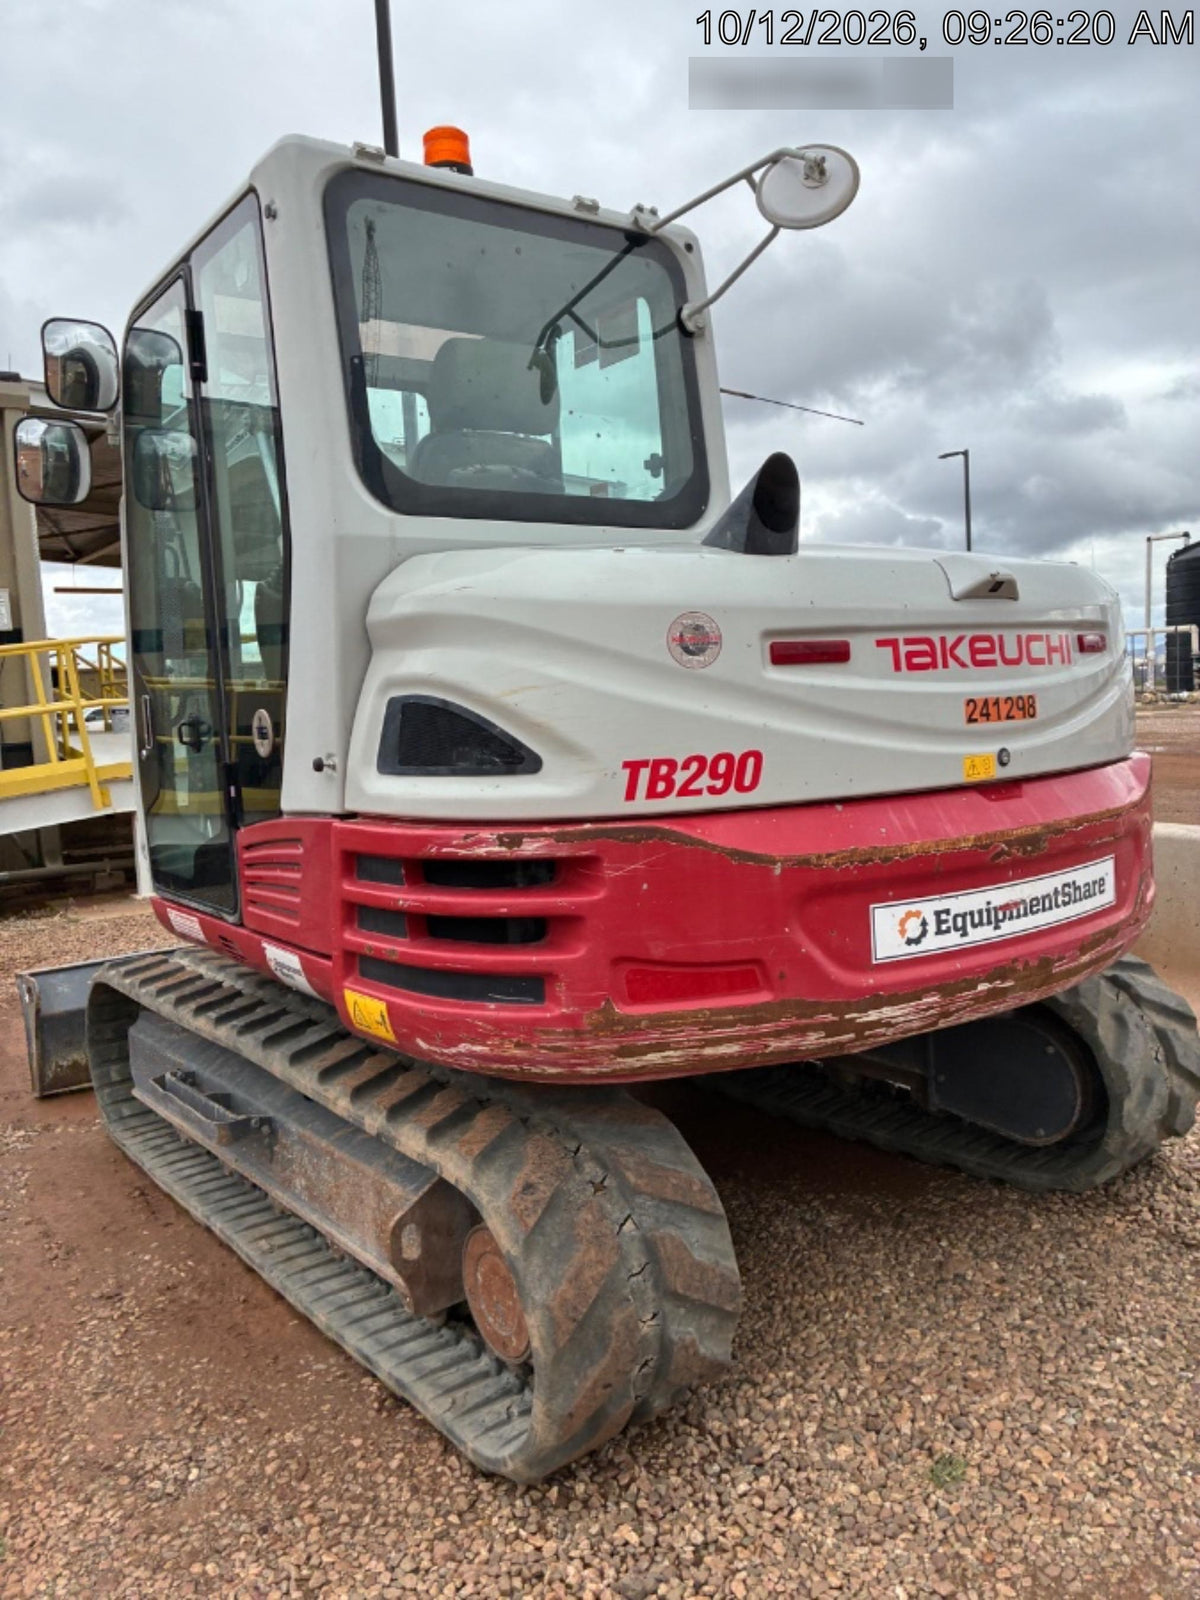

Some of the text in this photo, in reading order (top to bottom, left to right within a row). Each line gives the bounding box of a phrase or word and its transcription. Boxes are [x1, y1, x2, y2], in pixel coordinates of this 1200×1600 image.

[965, 694, 1037, 724] 241298
[622, 749, 763, 802] TB290
[934, 875, 1106, 938] EquipmentShare
